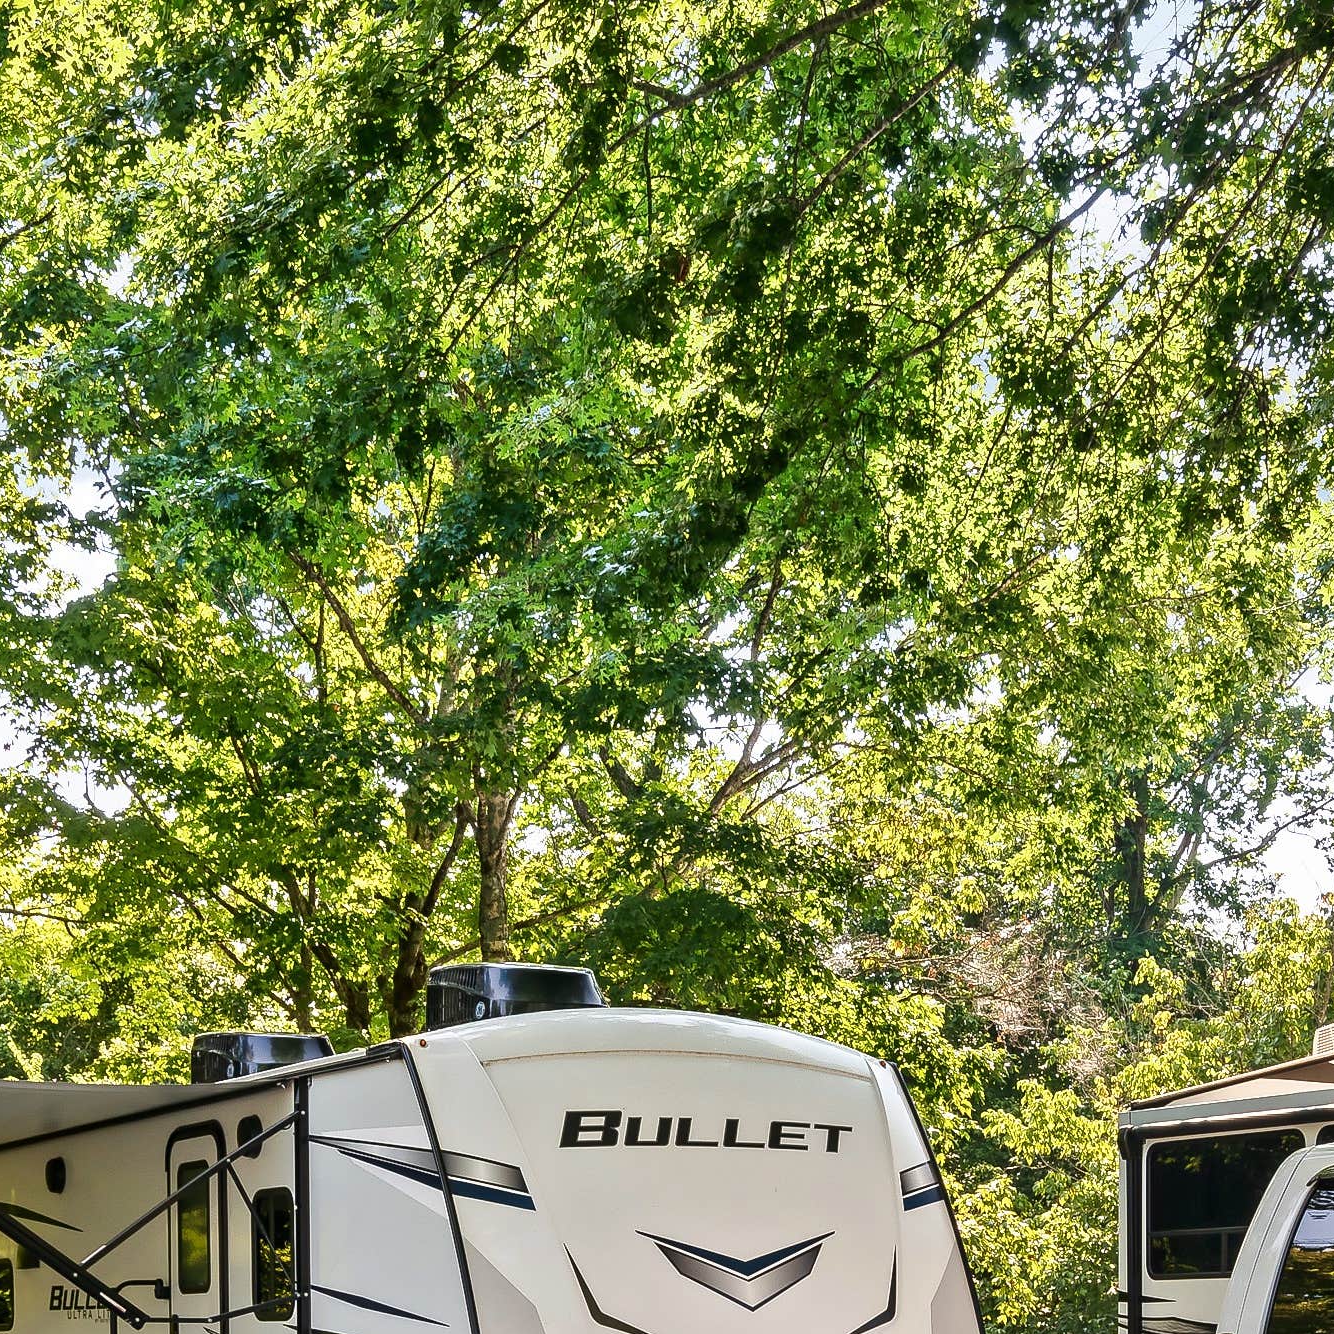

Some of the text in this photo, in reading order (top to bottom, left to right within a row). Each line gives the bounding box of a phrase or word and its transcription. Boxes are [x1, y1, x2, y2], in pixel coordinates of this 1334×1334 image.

[558, 1109, 854, 1154] BULLET
[49, 1285, 109, 1311] BULL
[67, 1309, 93, 1320] ULTRA
